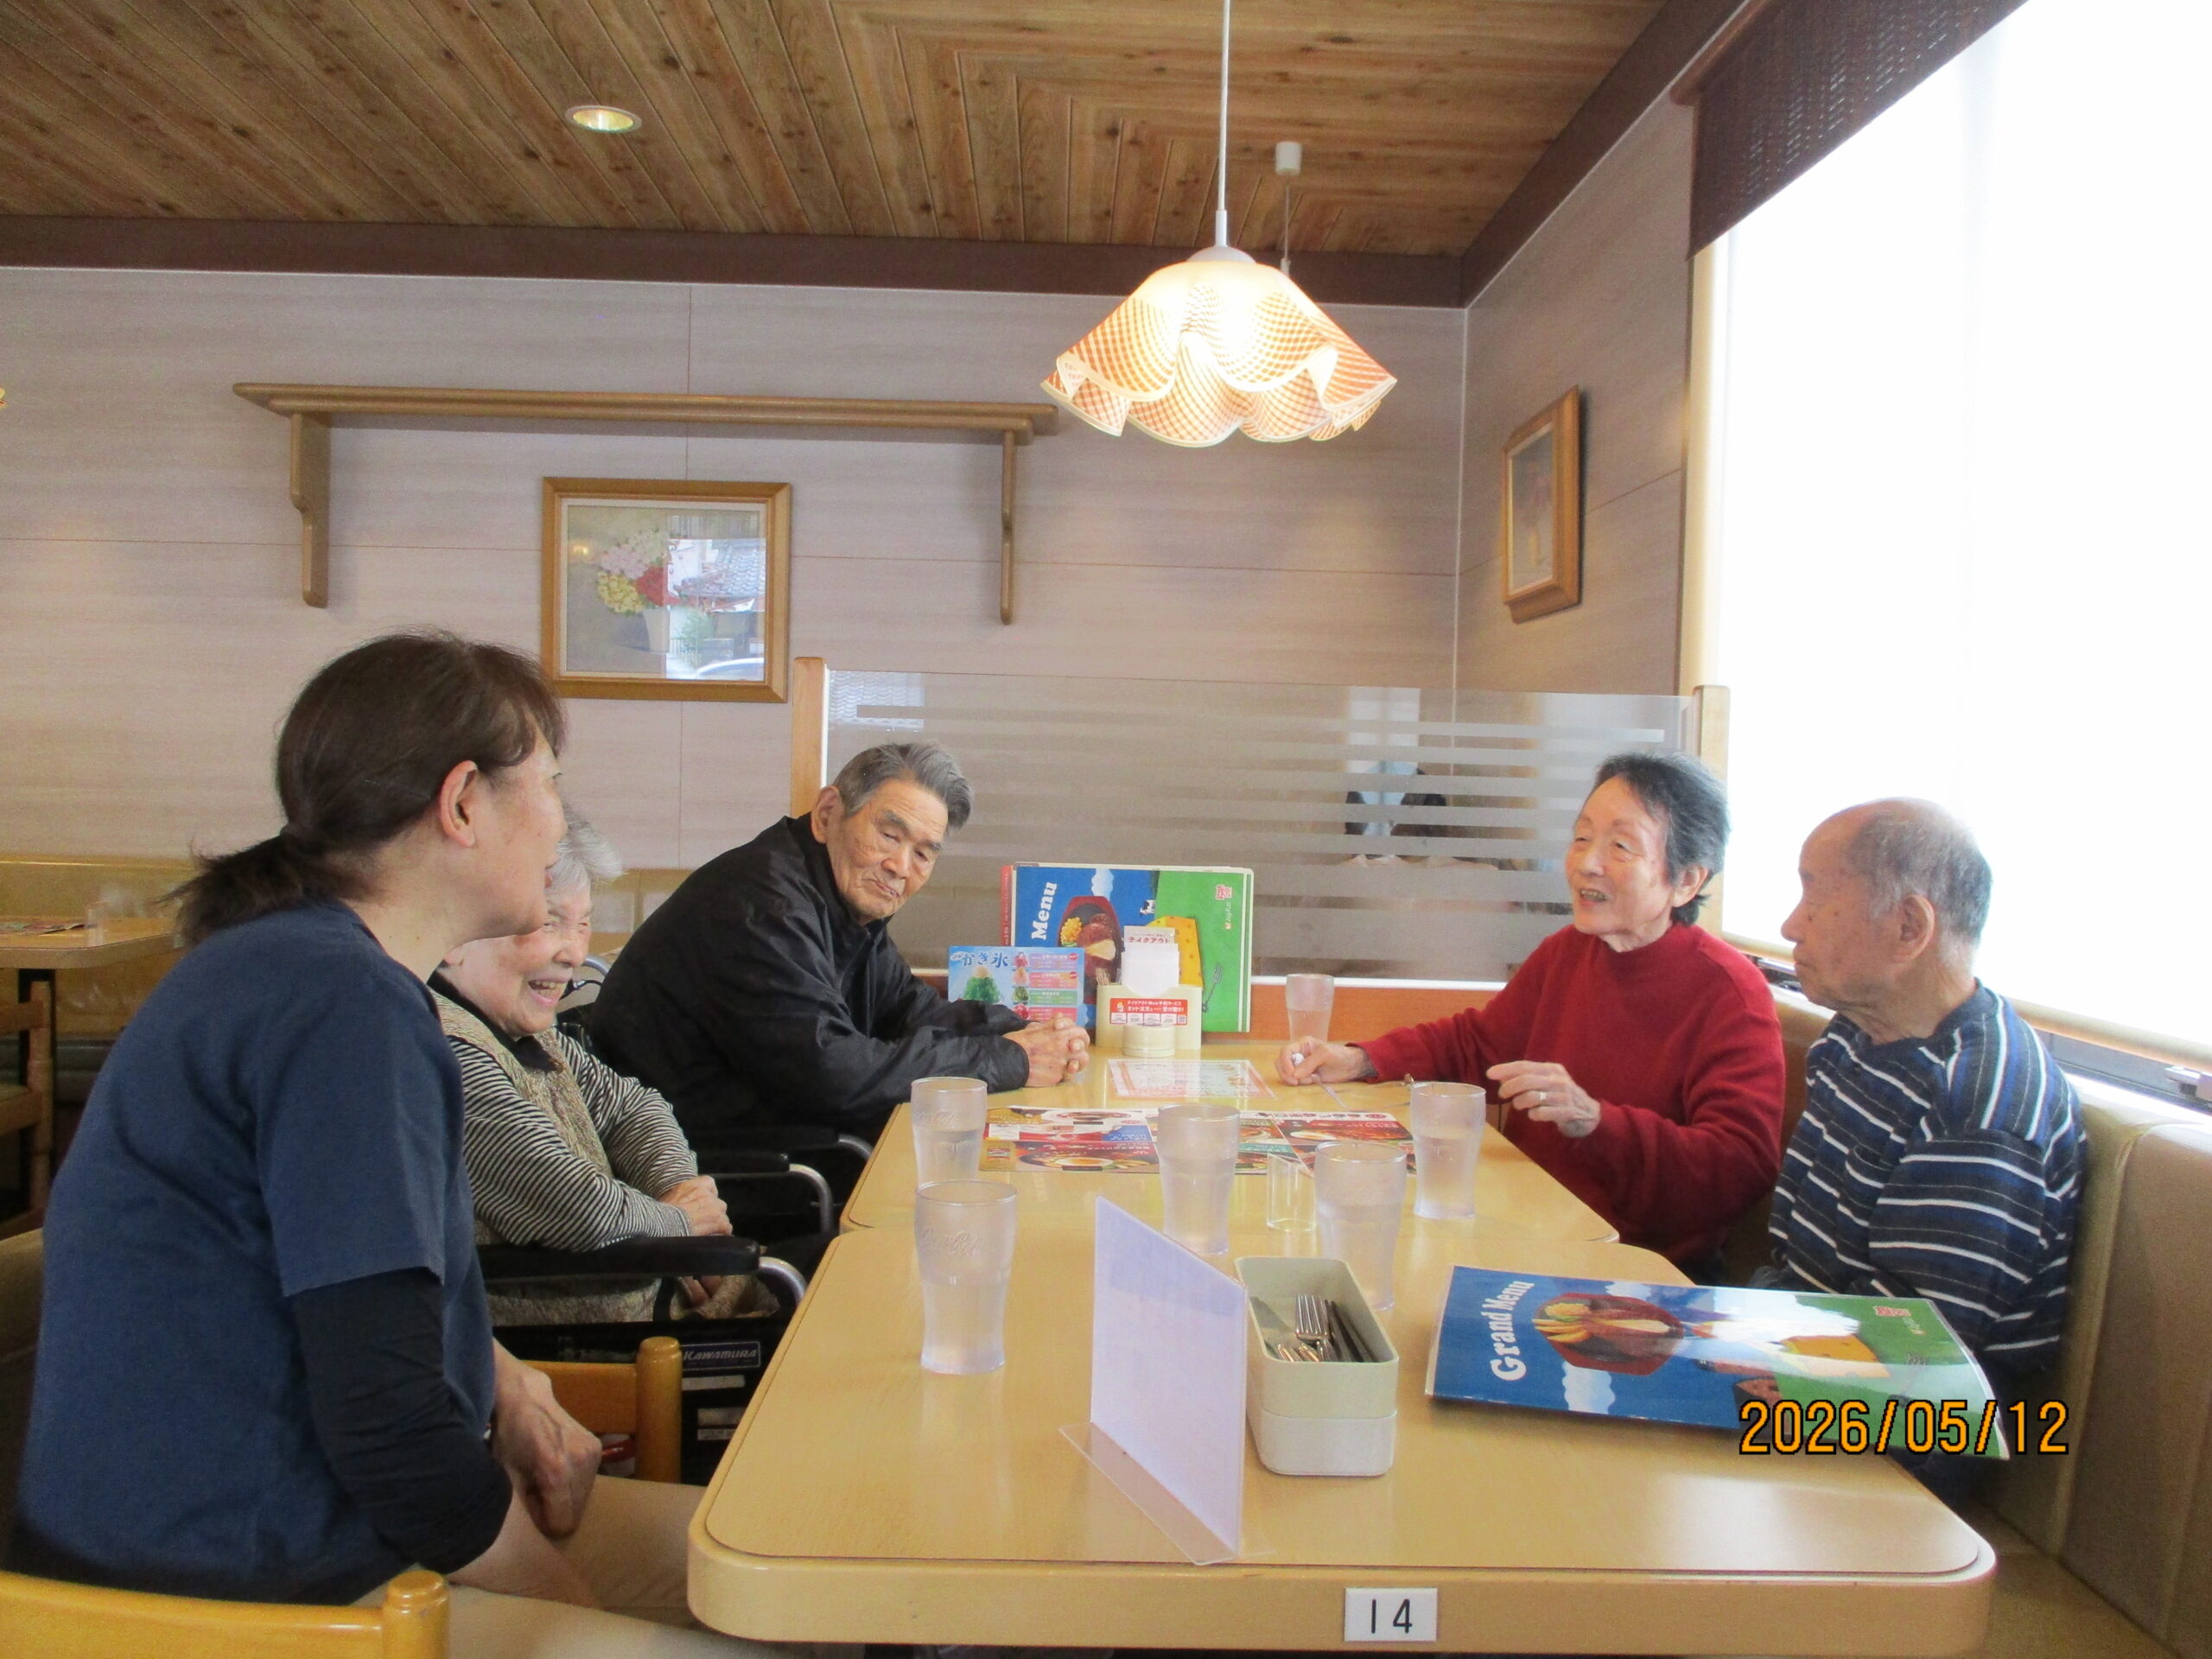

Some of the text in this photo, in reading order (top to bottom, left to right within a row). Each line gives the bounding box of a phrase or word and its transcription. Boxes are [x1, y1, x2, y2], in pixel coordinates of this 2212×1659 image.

[1031, 881, 1058, 941] Menu
[962, 951, 1009, 969] かき氷
[1480, 1280, 1535, 1382] Grand Menu
[683, 1349, 758, 1362] KAWAMURA
[1370, 1598, 1414, 1635] 14
